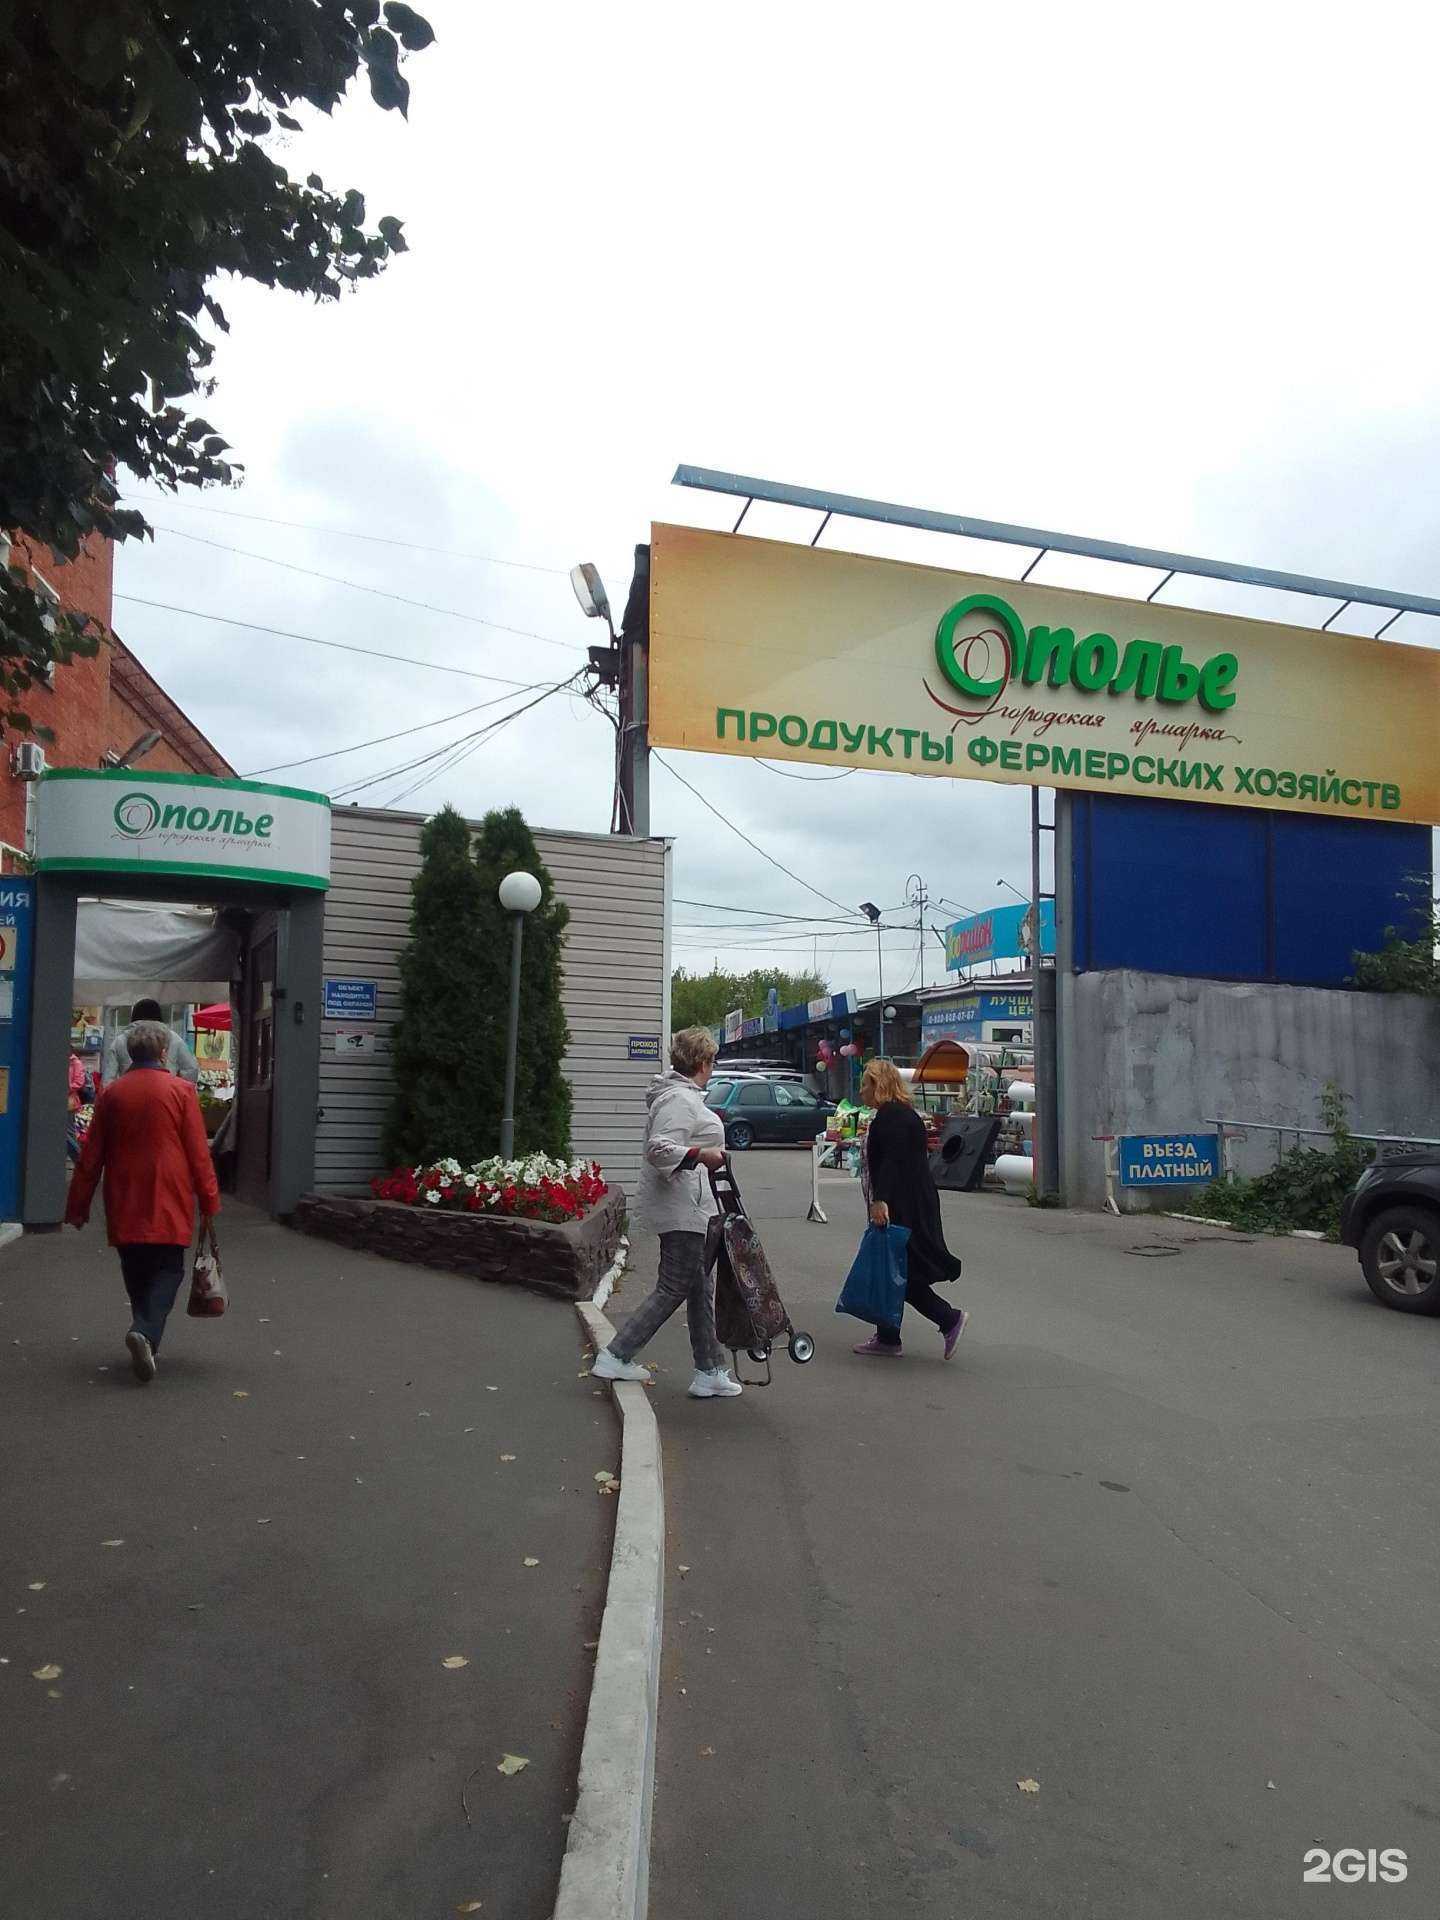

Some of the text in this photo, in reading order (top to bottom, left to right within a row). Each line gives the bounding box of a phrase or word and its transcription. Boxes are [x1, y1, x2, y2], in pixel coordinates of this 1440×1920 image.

[935, 593, 1239, 712] Ополье
[999, 704, 1241, 751] городская ярмарка
[716, 706, 1402, 810] ПРОДУКТЫ ФЕРМЕРСКИХ ХОЗЯЙСТВ
[114, 792, 274, 838] Ополье
[990, 996, 1034, 1006] ЛУЧШ
[1129, 1159, 1212, 1178] ПЛАТНЫЙ
[1143, 1142, 1198, 1158] ВЪЕЗД
